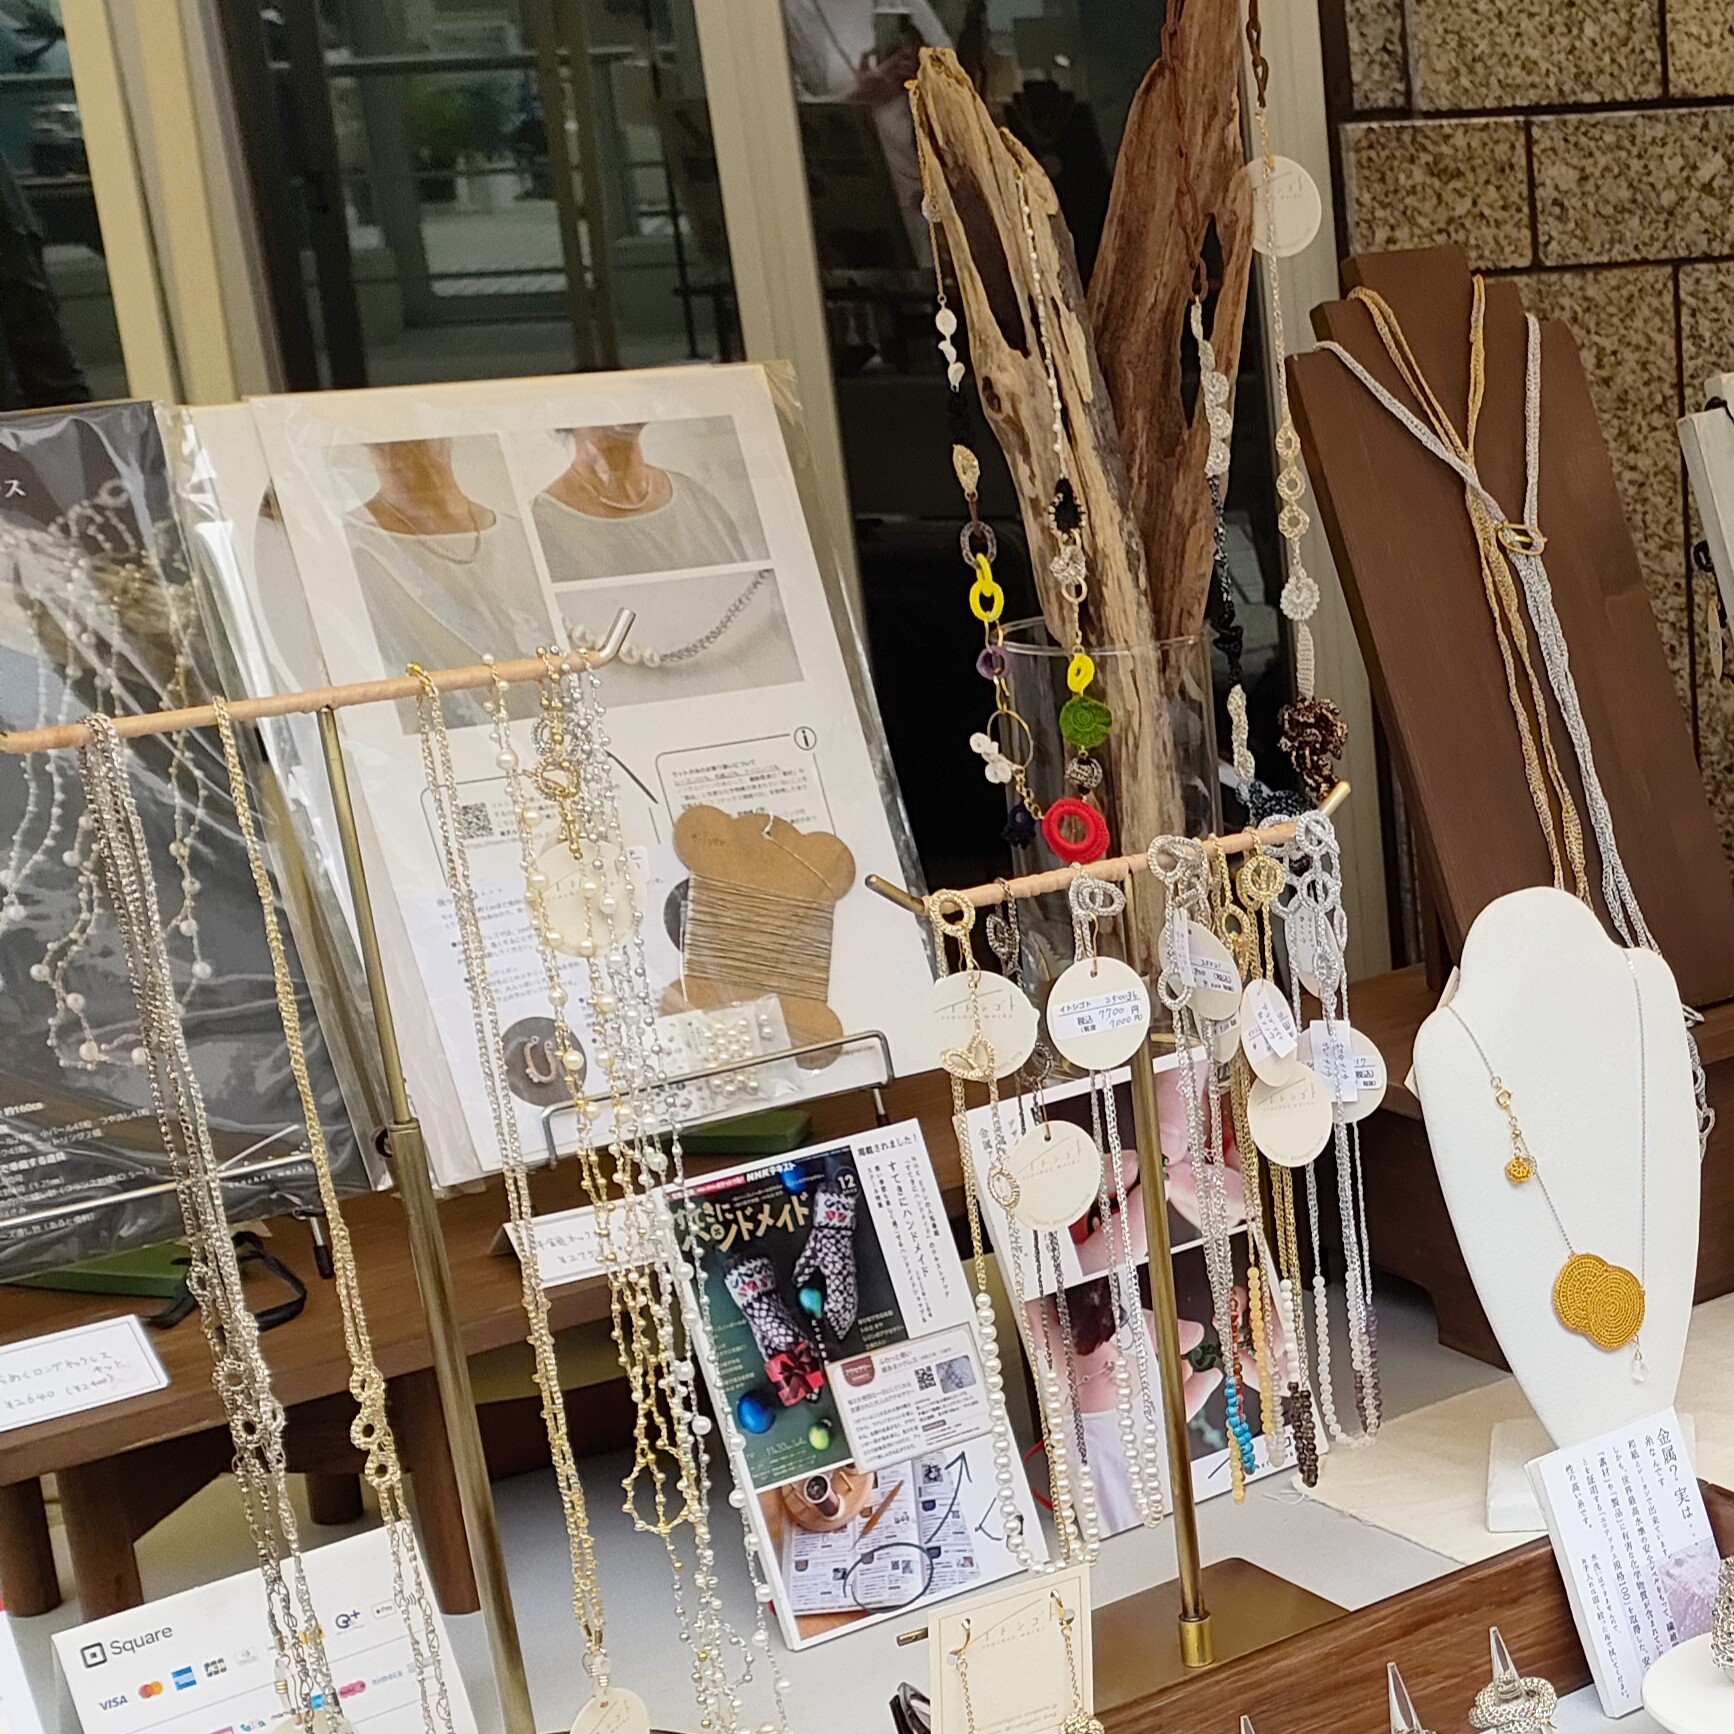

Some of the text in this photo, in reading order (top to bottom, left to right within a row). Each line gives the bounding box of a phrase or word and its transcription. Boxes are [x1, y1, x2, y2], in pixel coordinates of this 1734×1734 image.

[746, 1163, 797, 1183] NHKテキスト
[837, 1174, 857, 1190] 12
[1644, 1434, 1666, 1488] 糸なんです
[1564, 1463, 1593, 1529] 性の高い糸です。
[110, 1626, 173, 1657] Square
[99, 1695, 129, 1711] VISA
